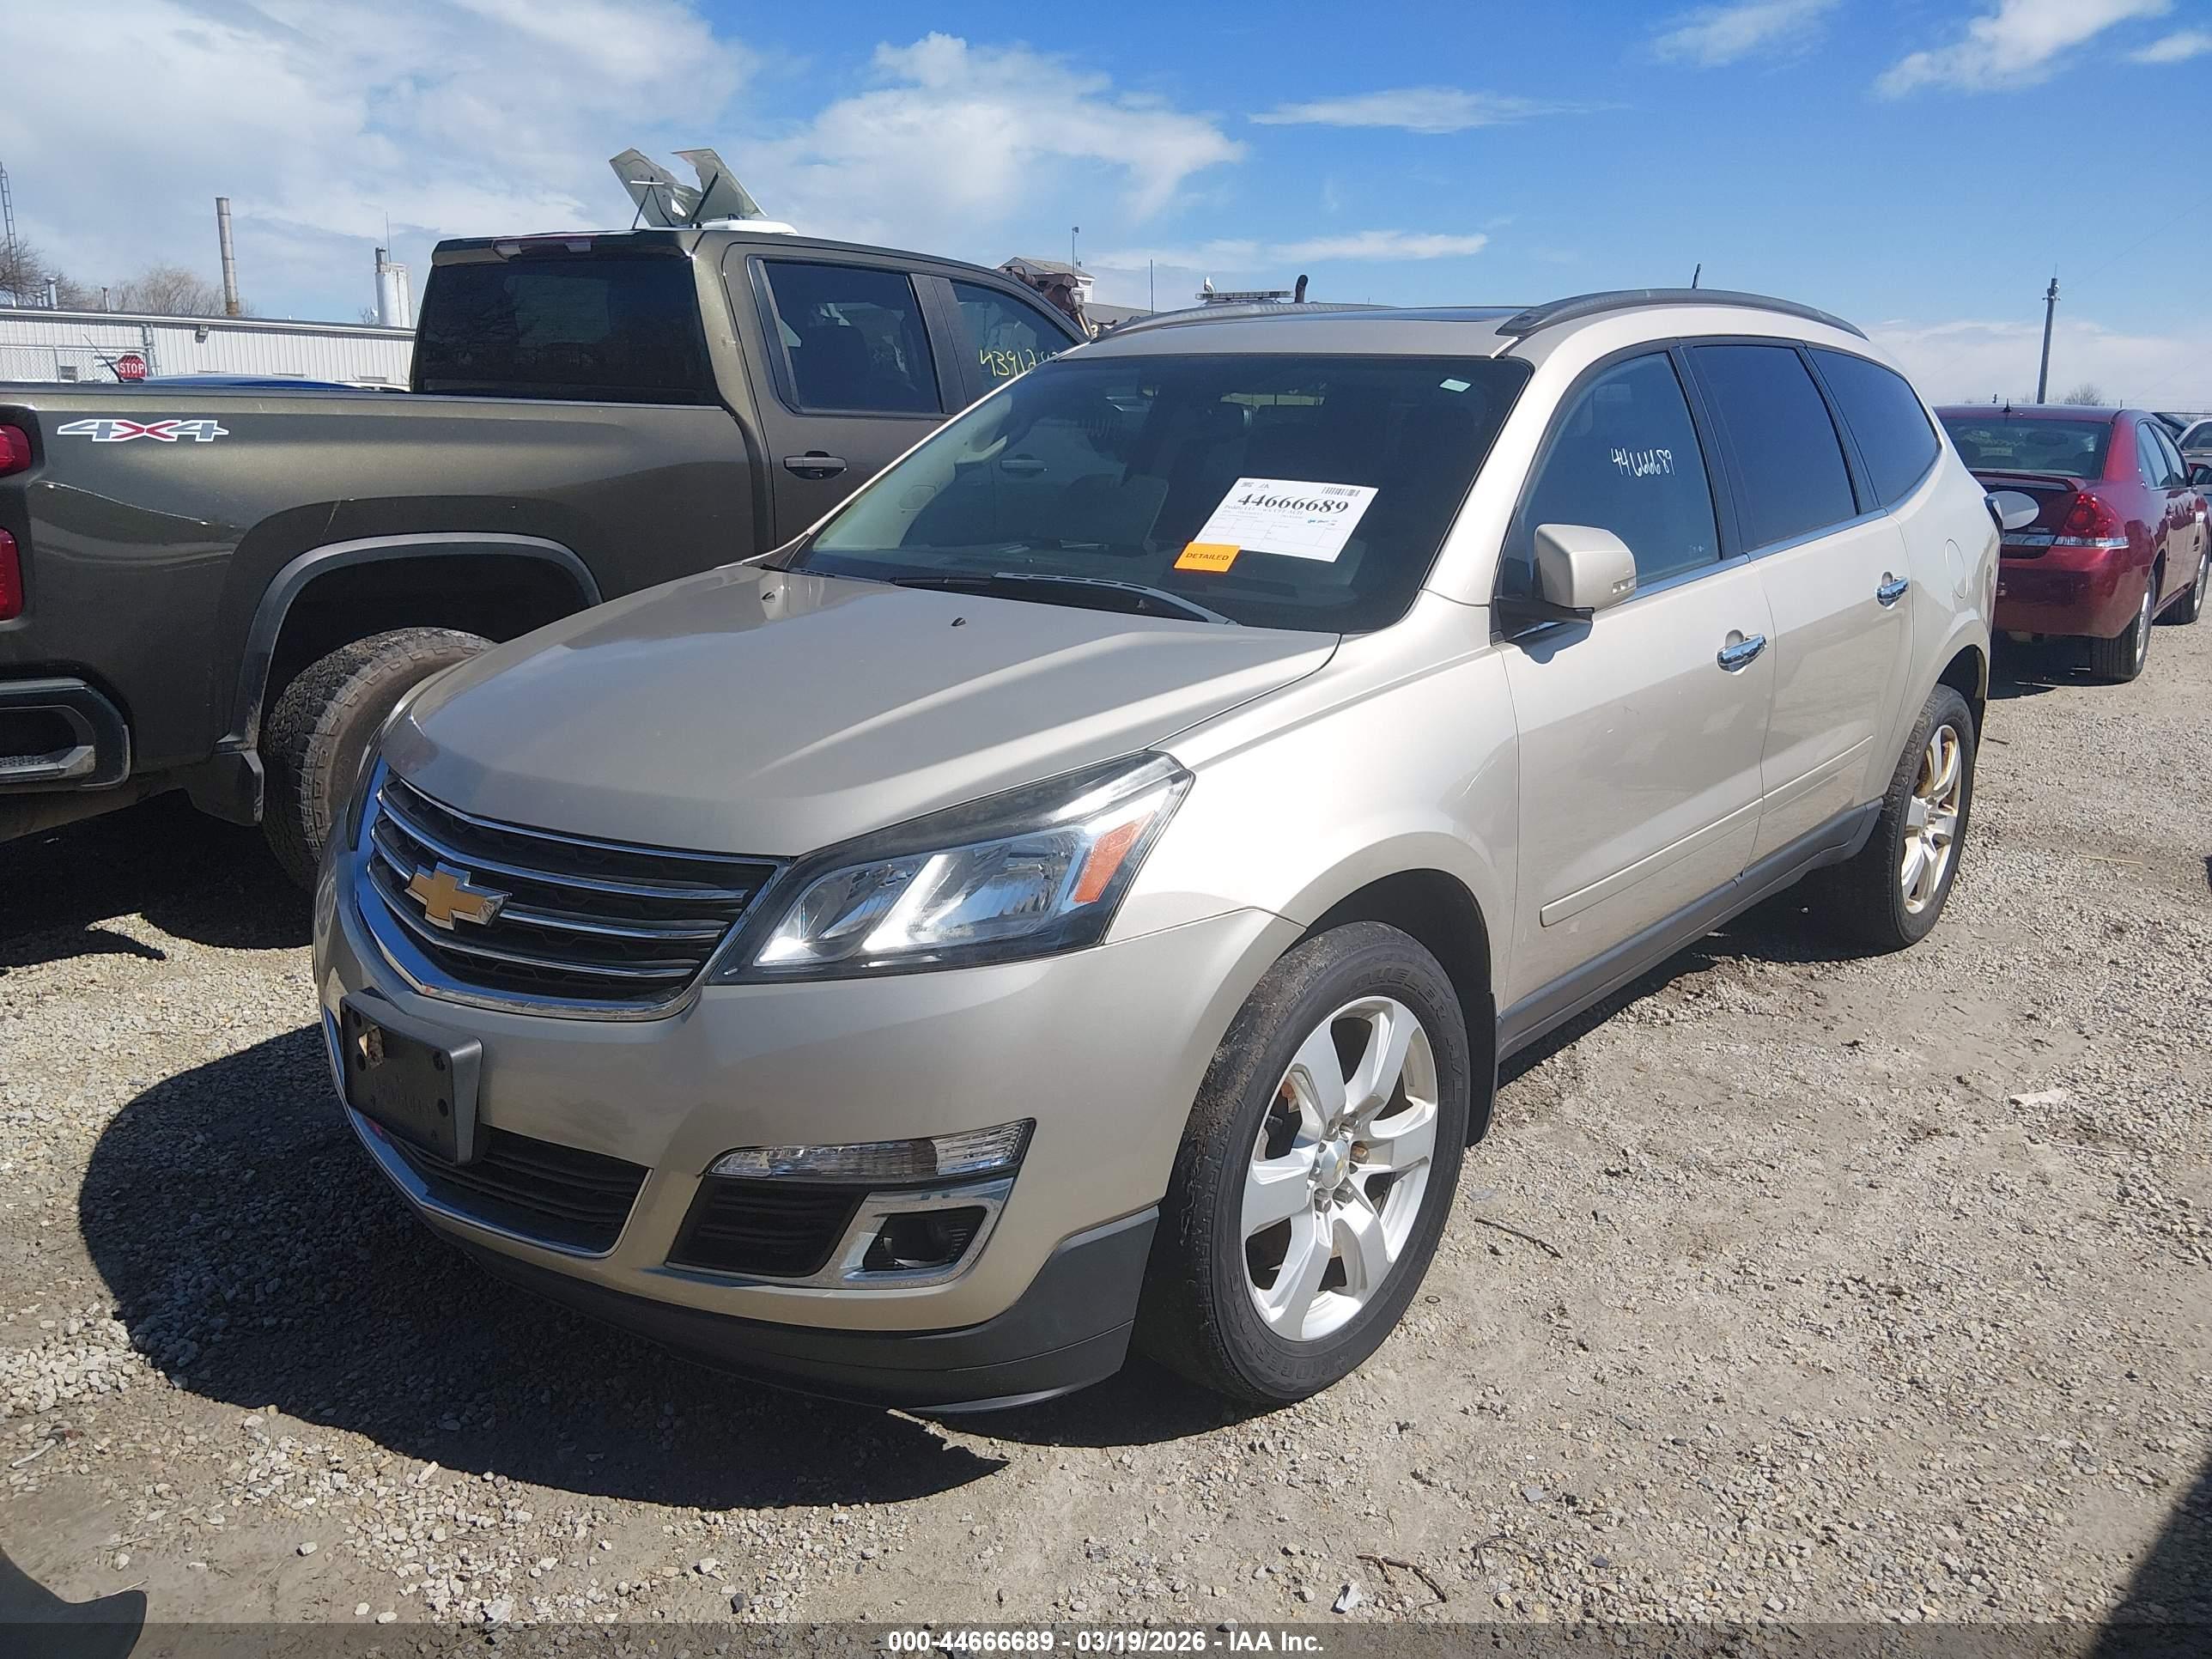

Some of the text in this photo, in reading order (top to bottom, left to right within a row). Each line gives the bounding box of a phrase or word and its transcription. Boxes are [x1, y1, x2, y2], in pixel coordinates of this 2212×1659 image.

[119, 362, 144, 374] STOP
[57, 419, 229, 441] 4X4
[1610, 447, 1675, 477] 44666689
[1237, 493, 1349, 514] 44666689
[1186, 552, 1229, 561] DETAILED
